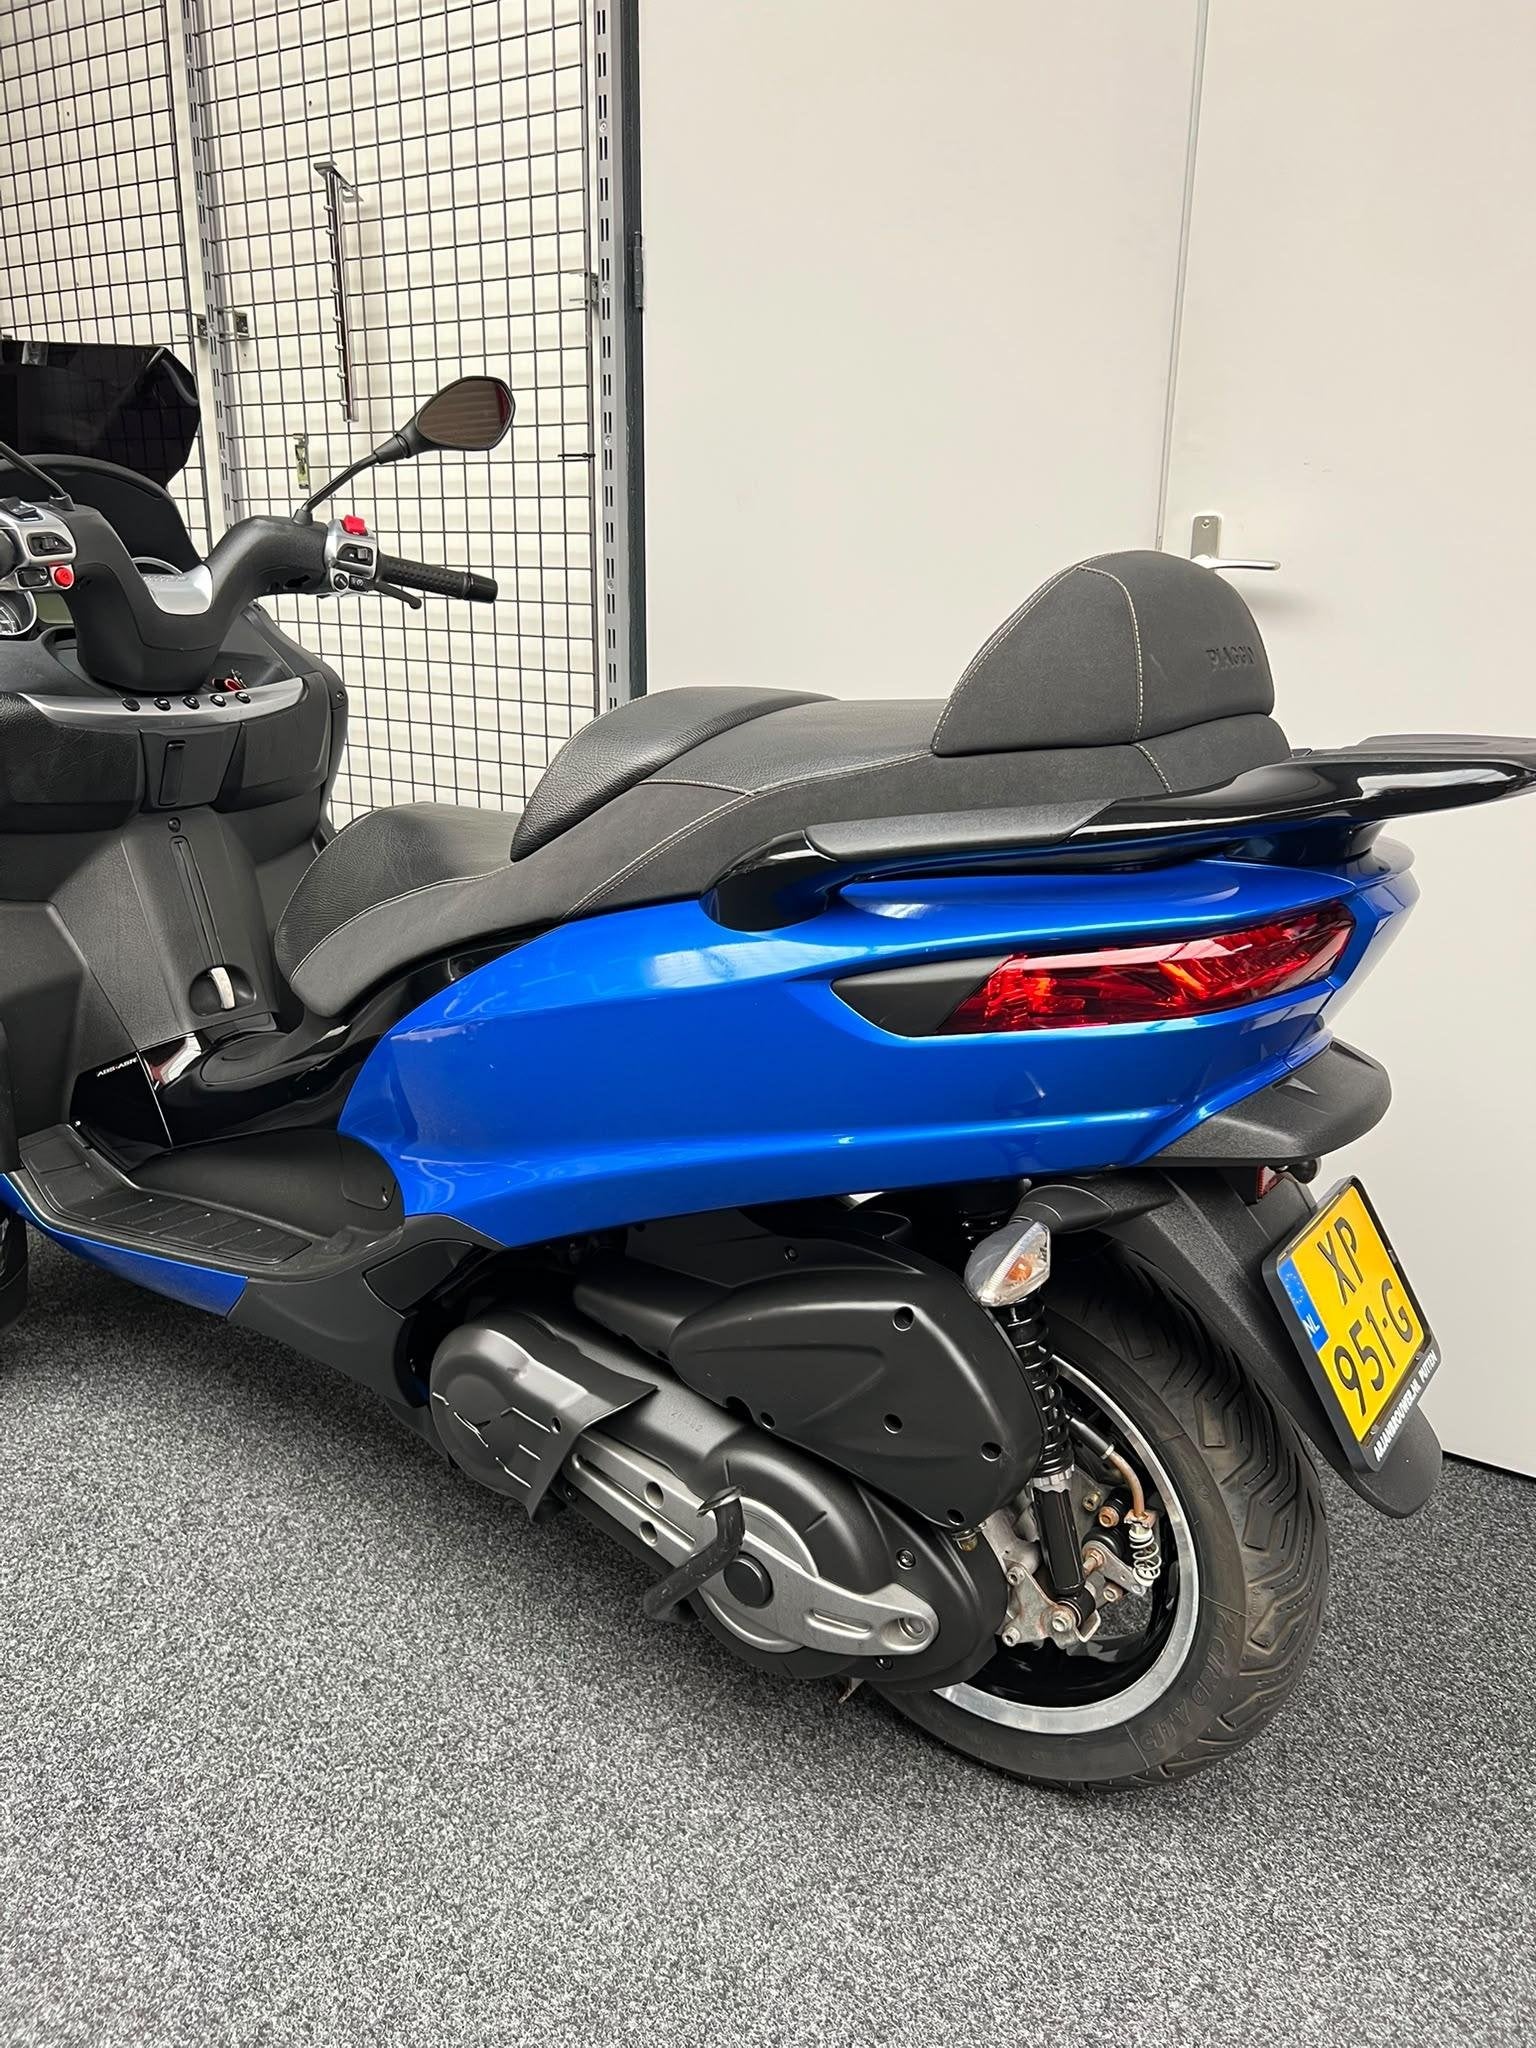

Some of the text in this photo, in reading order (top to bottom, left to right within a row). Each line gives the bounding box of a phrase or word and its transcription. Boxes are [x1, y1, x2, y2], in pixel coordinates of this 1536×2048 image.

[1317, 1217, 1363, 1305] XP
[1302, 1314, 1320, 1338] NL
[1334, 1278, 1413, 1416] 951-G
[1418, 1350, 1438, 1383] PUTTEN
